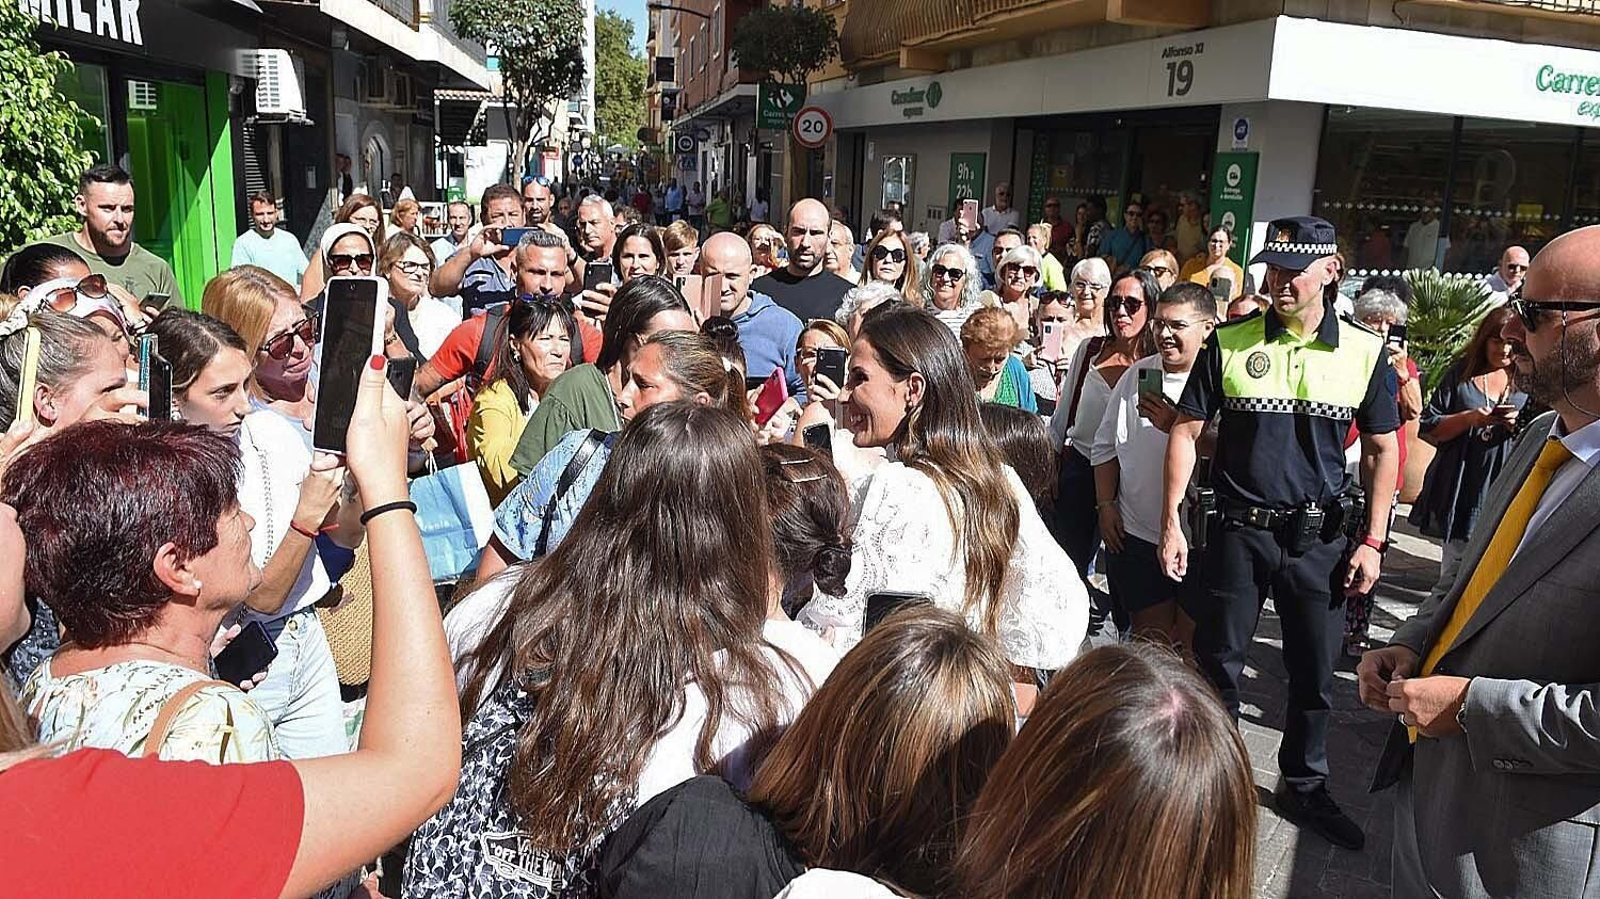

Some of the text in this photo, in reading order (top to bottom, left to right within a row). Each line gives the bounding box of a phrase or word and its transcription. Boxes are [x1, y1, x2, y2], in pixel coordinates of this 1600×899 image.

[1162, 43, 1204, 58] Alfonso XI
[1167, 60, 1194, 97] 19
[802, 119, 824, 133] 20
[958, 162, 969, 179] 9h
[956, 184, 973, 199] 22h
[519, 853, 542, 875] THE
